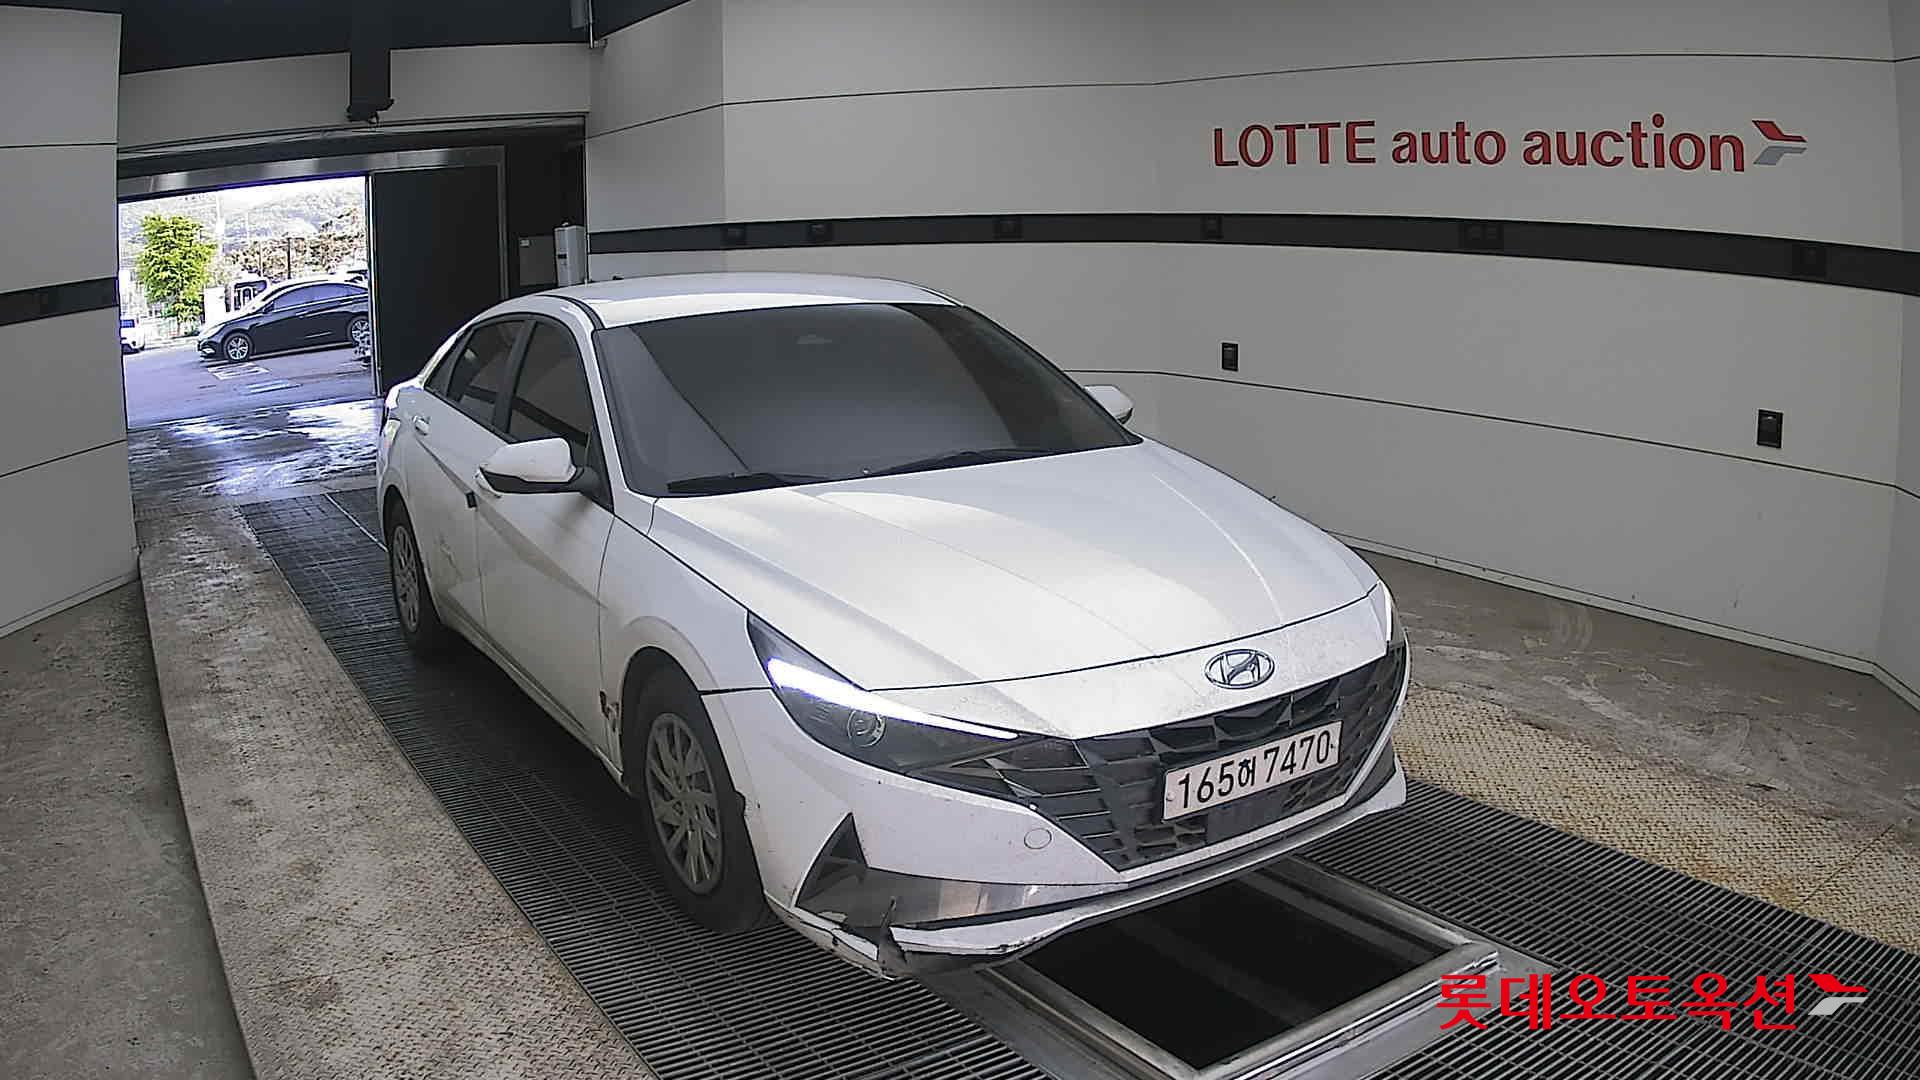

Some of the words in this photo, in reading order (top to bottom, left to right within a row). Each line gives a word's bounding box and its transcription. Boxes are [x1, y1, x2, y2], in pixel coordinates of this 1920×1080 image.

[1214, 120, 1377, 168] LOTTE
[1391, 121, 1506, 166] auto
[1522, 113, 1746, 173] auction
[1263, 730, 1331, 784] 7470
